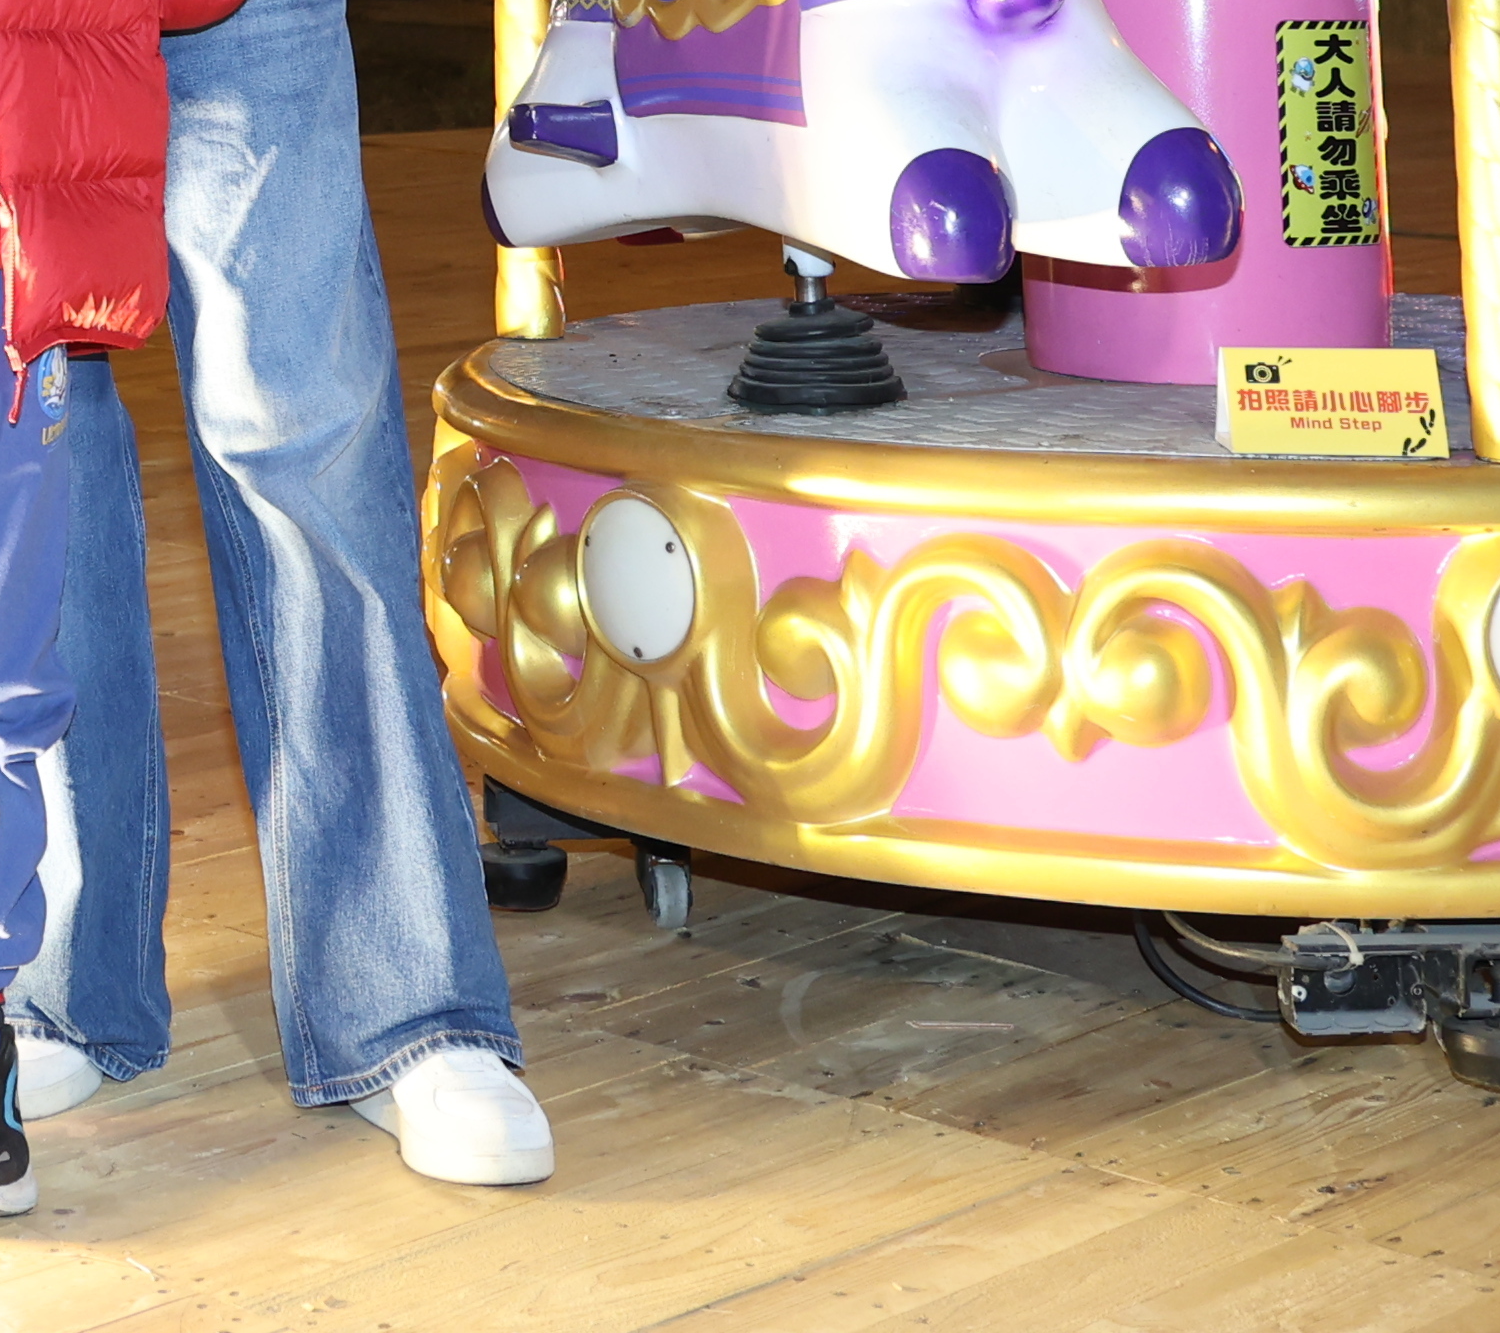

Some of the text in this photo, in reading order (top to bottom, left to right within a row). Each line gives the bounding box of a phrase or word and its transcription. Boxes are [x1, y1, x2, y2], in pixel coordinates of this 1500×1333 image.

[1313, 33, 1363, 234] 大人請勿乘坐
[1236, 388, 1430, 414] 拍照請小心腳步
[1290, 416, 1383, 432] Mind Step
